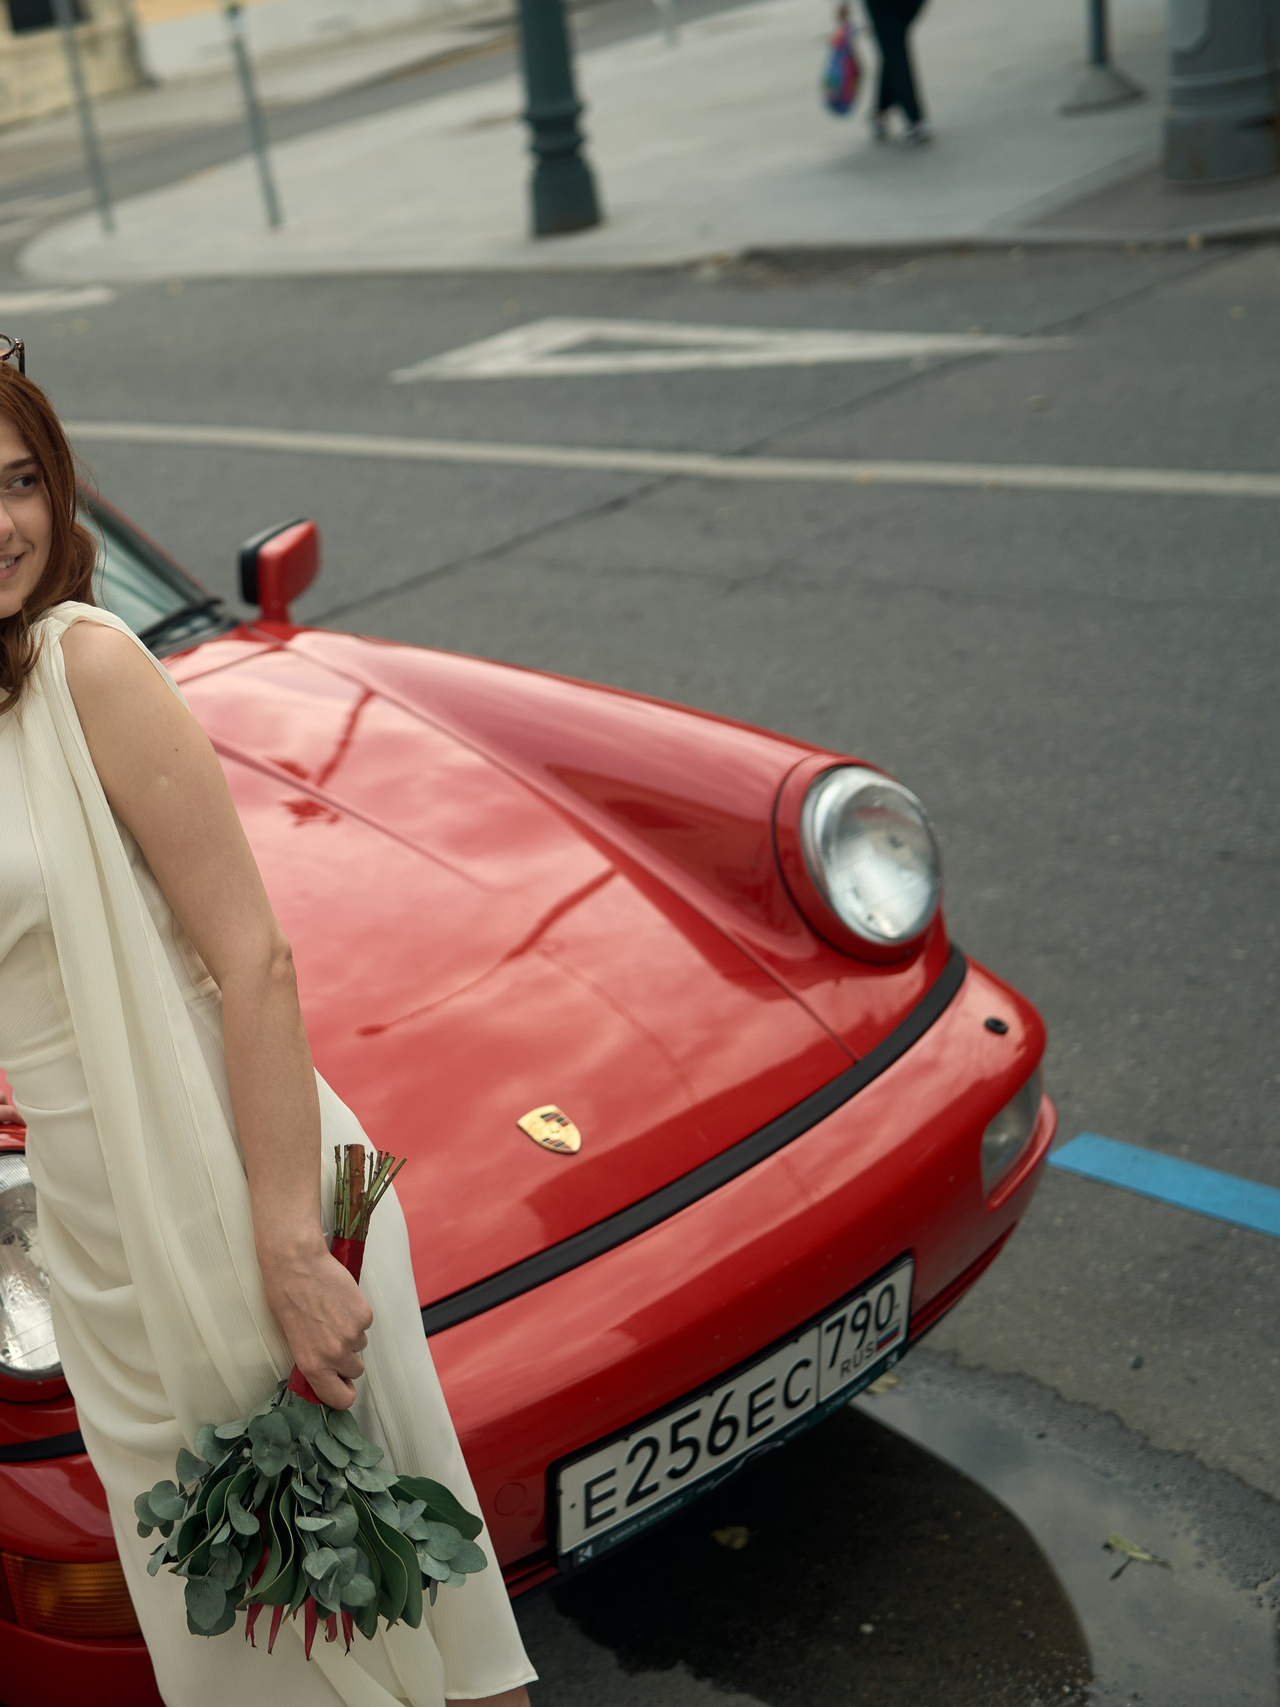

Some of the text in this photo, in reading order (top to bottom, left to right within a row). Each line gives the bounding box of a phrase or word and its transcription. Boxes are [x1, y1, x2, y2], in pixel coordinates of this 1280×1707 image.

[583, 1283, 895, 1529] E256EC 790
[841, 1341, 875, 1377] RUS
